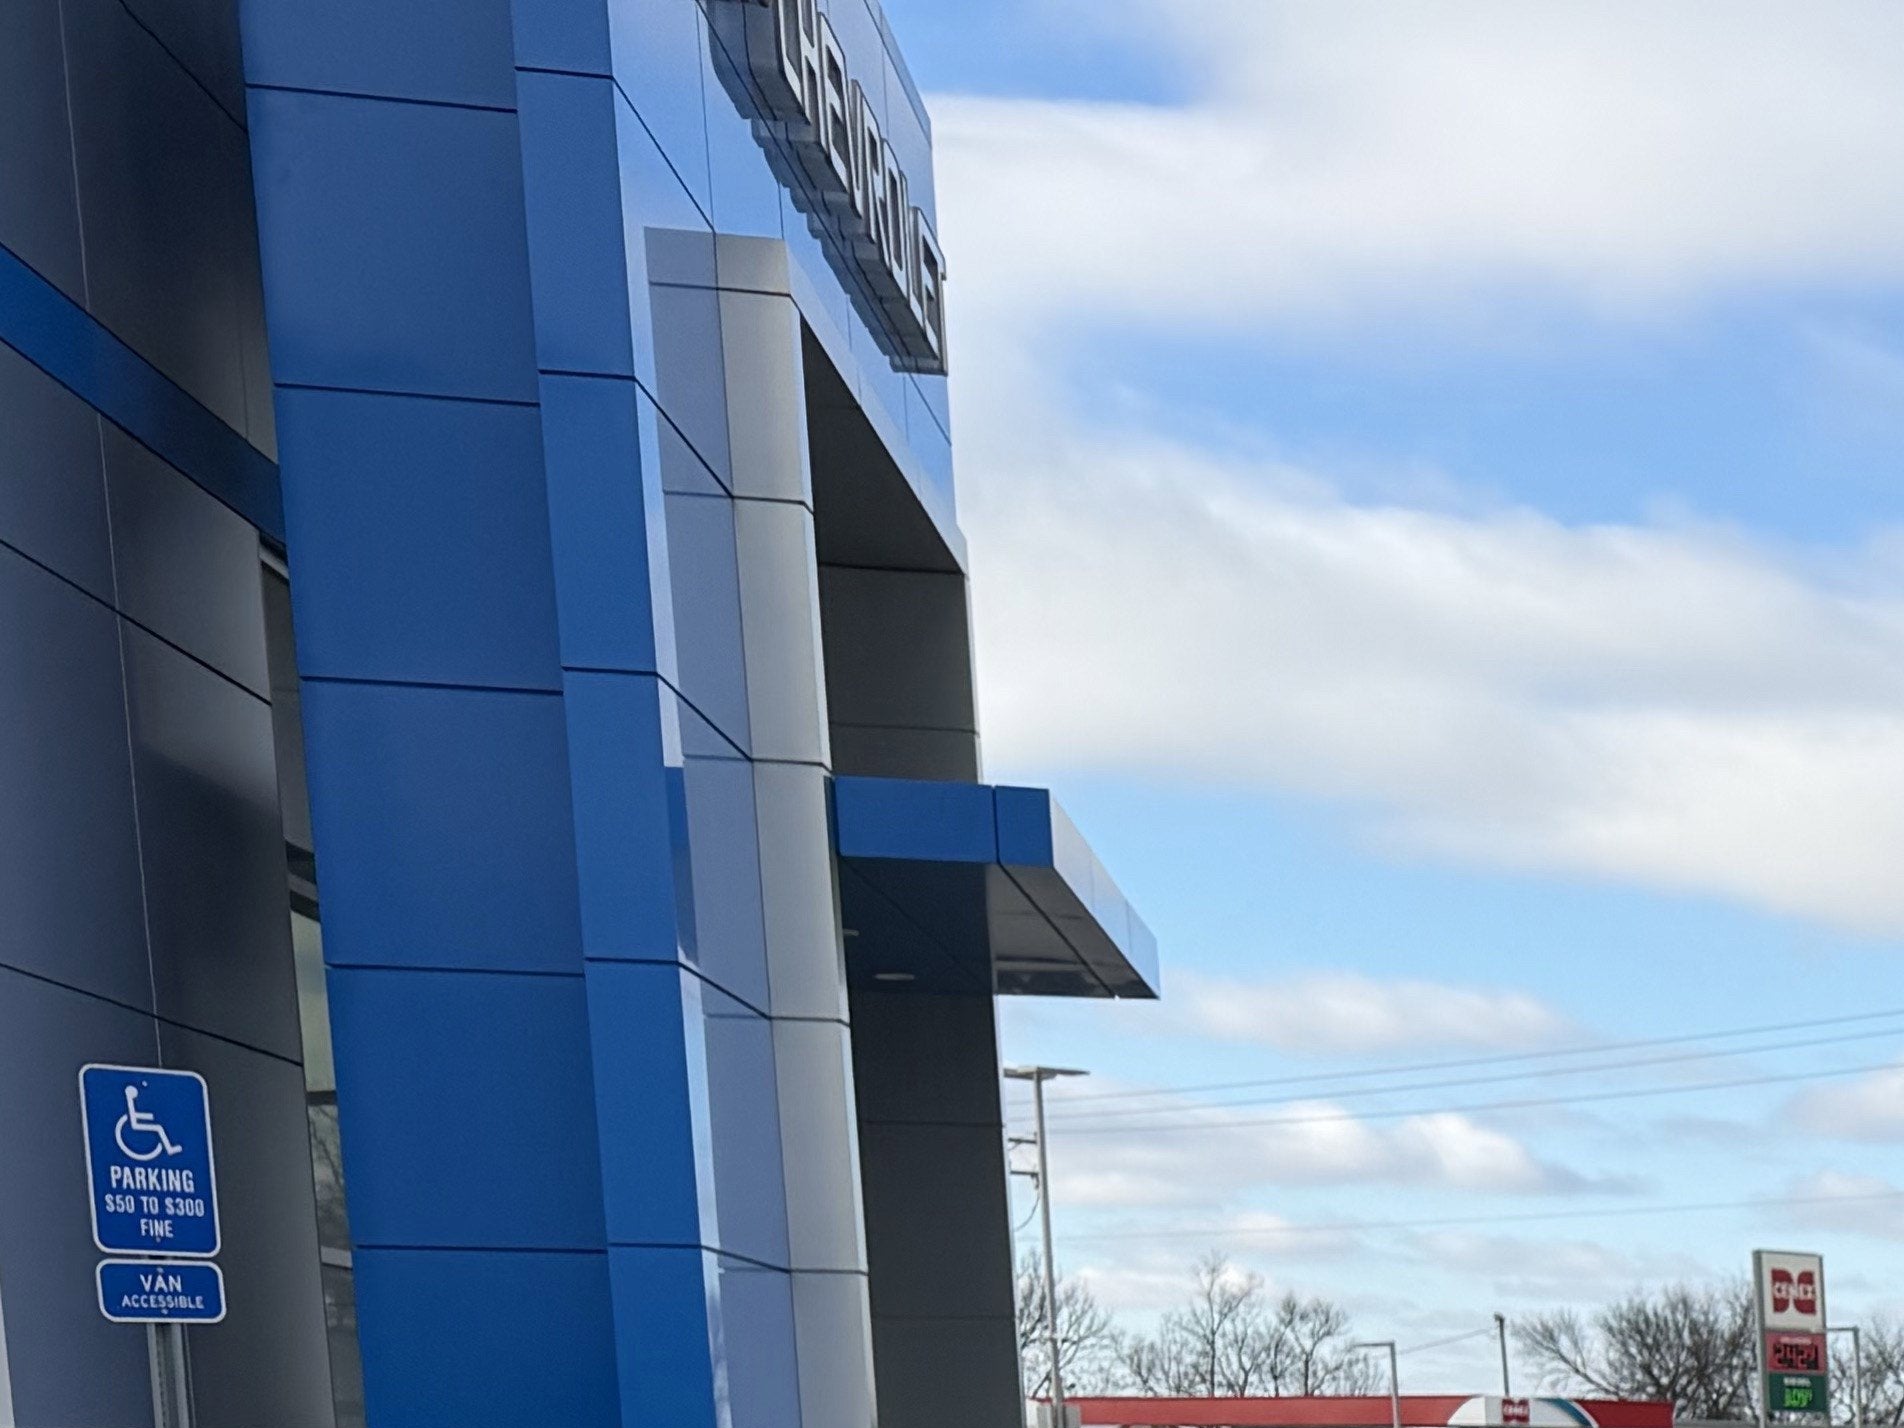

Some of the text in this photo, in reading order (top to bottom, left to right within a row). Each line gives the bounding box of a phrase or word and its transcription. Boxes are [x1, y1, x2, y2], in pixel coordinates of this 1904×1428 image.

[110, 1165, 195, 1194] PARKING
[104, 1194, 205, 1217] $50 TO $300
[140, 1218, 174, 1239] FINE
[139, 1273, 183, 1293] VAN
[121, 1294, 205, 1310] ACCESSIBLE
